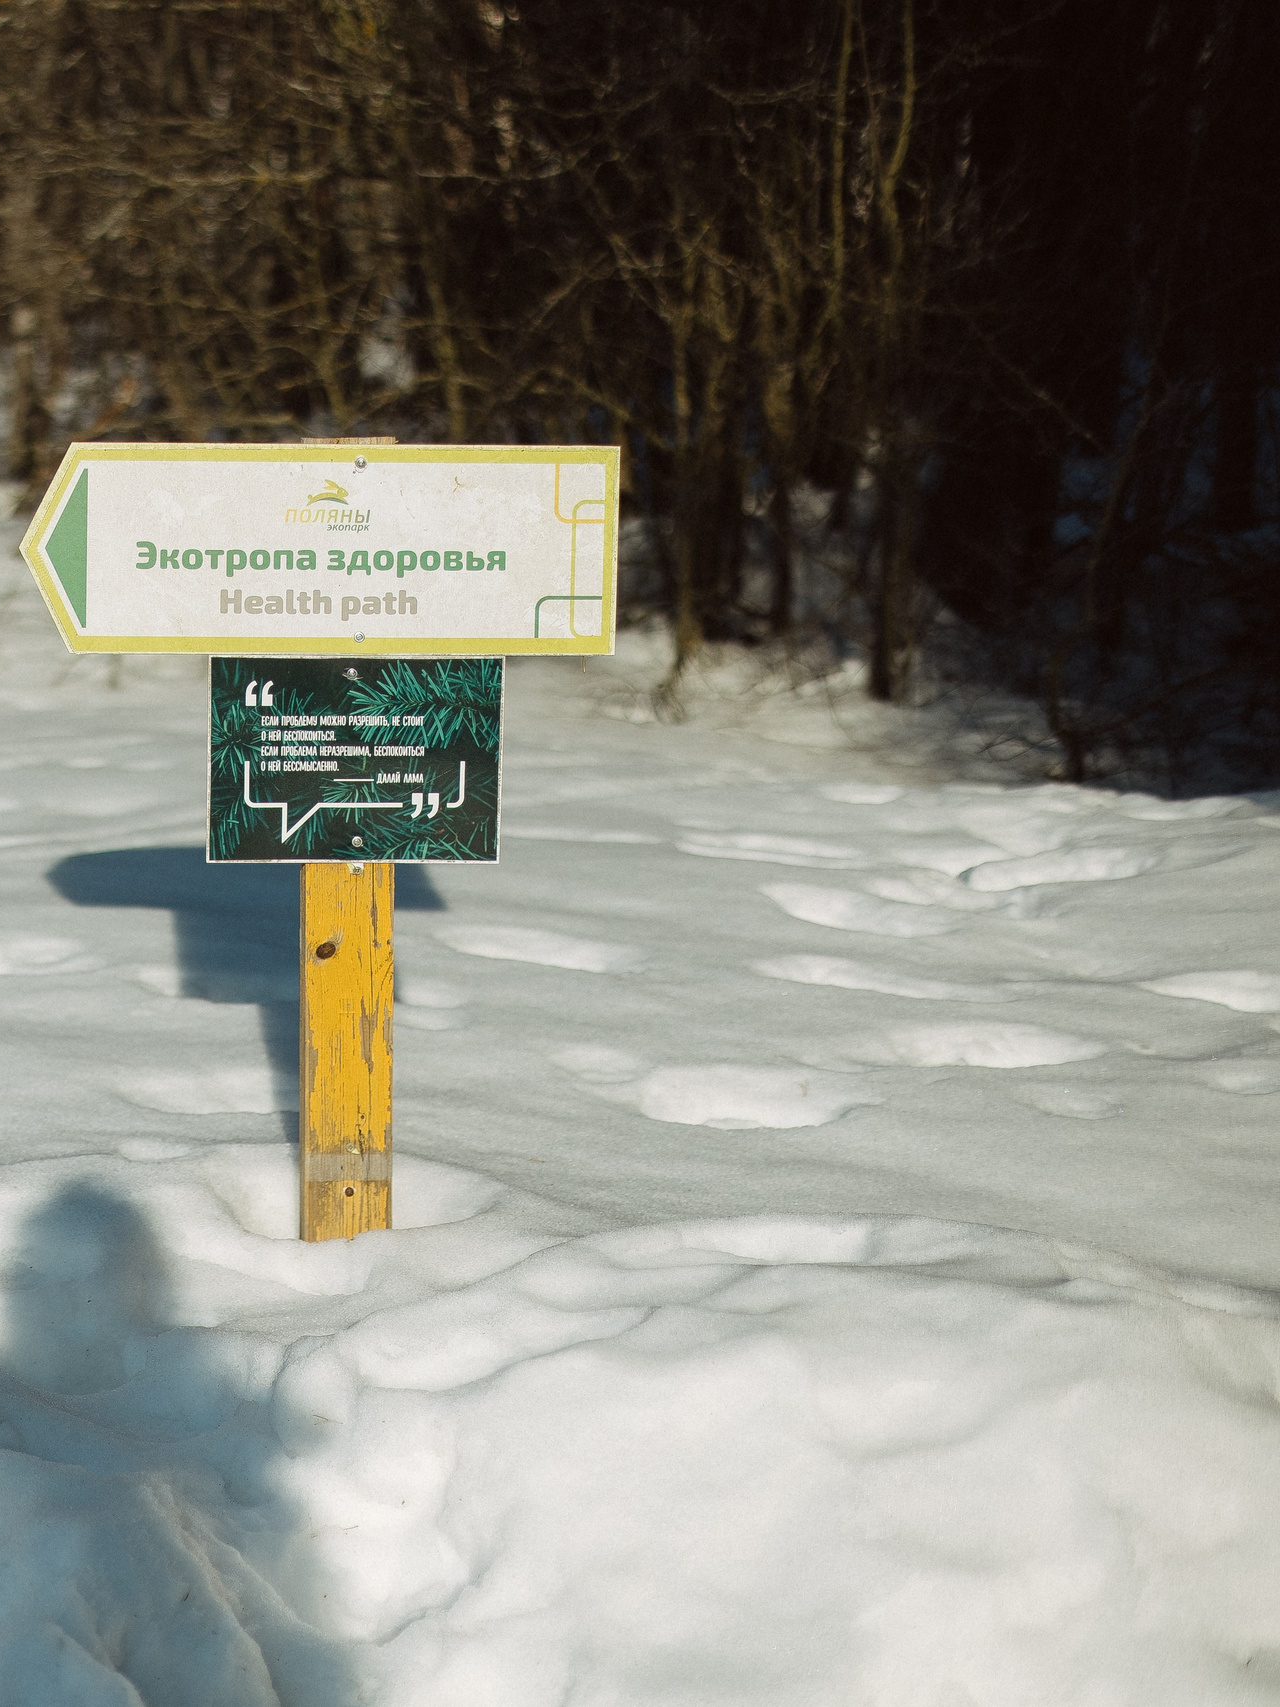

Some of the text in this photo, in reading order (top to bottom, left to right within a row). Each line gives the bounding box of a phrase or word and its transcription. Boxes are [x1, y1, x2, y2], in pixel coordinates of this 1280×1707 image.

[285, 508, 370, 524] ПОЛЯНЫ
[326, 524, 370, 533] экопарк
[136, 541, 507, 578] Экотропа здоровья
[220, 589, 418, 621] Health path
[261, 715, 425, 727] ЕСЛИ ПРОБЛЕМУ МОЖНО РАЗРЕШИТЬ, НЕ СТОИТ
[261, 730, 337, 741] О НЕЙ БЕСПОКОИТЬСЯ.
[261, 746, 425, 757] ЕСЛИ ПРОБЛЕМА НЕРАЗРЕШИМА, БЕСПОКОИТЬСЯ
[260, 760, 340, 771] О НЕЙ БЕССМЫСЛЕННО.
[376, 772, 424, 784] ДАЛАЙ ЛАМА
